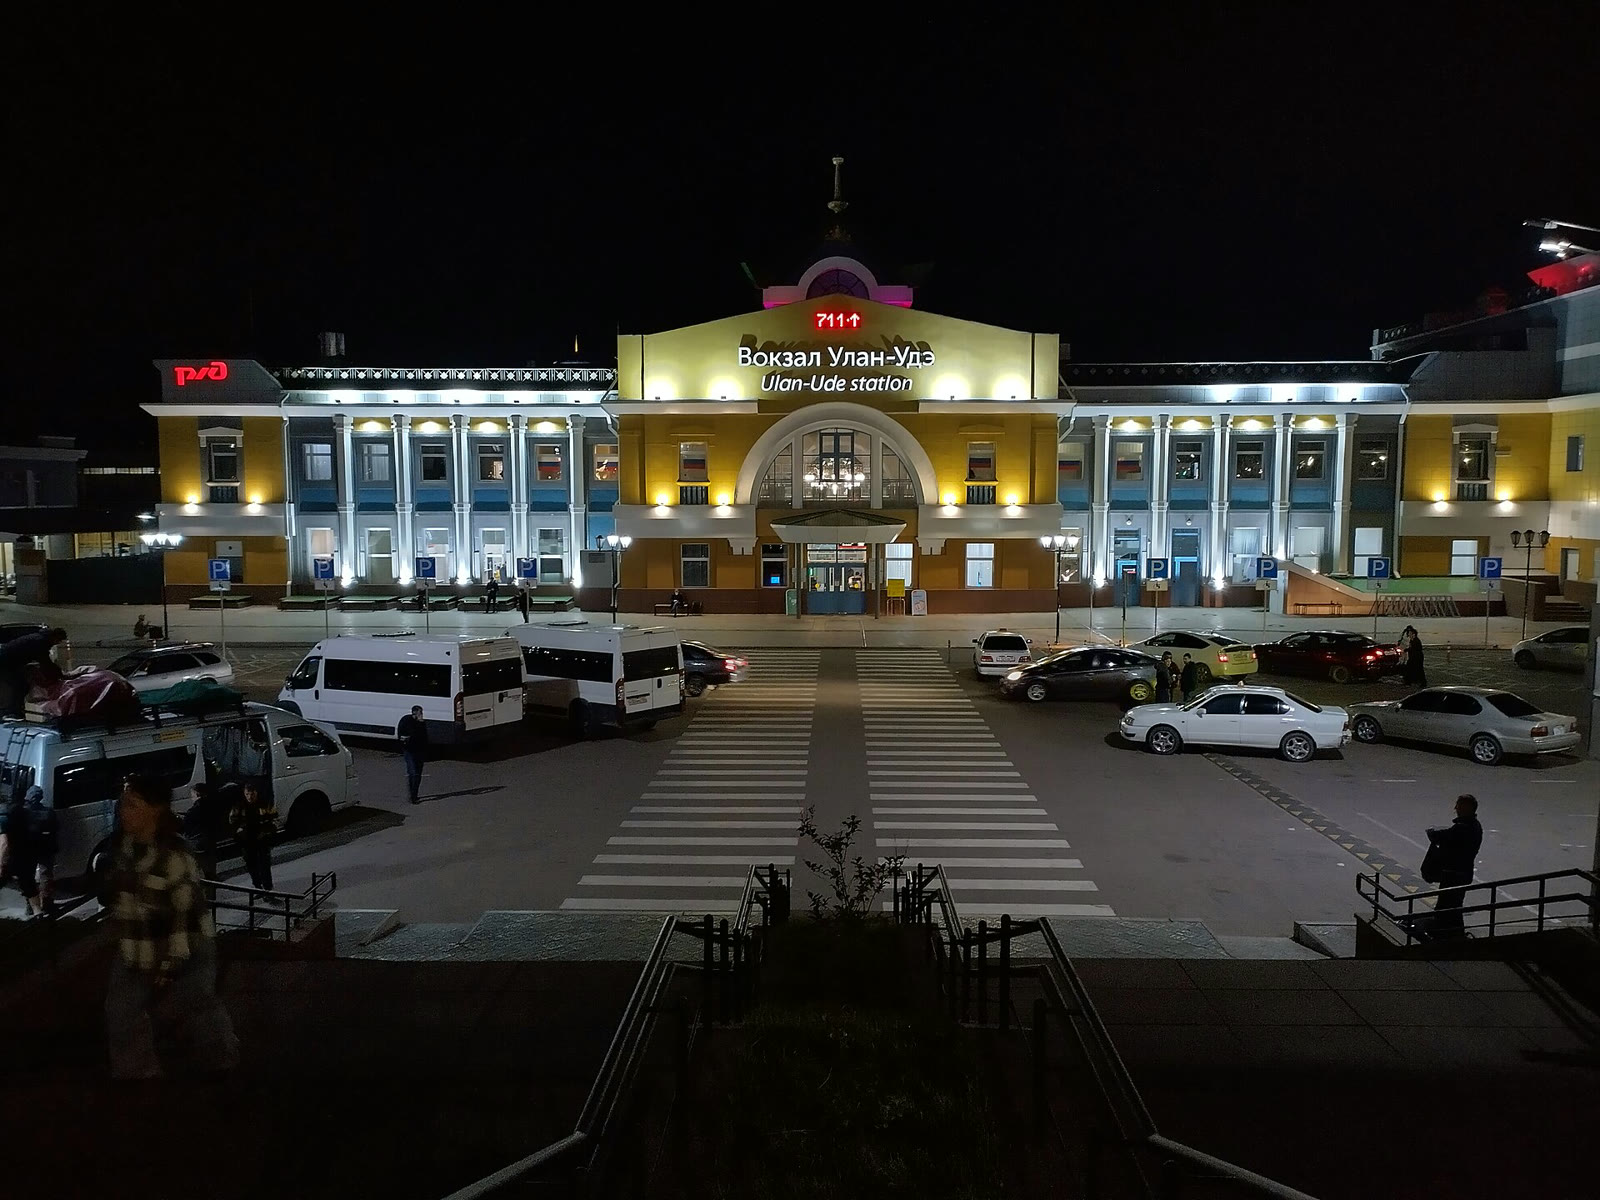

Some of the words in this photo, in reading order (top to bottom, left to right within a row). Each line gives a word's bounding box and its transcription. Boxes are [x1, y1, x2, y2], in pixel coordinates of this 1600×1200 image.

[738, 347, 821, 367] Вокзал
[827, 346, 936, 369] Улан-Удэ
[761, 374, 846, 391] Ulan-Ude
[849, 374, 913, 391] station
[213, 561, 225, 579] P
[318, 560, 330, 578] P
[420, 559, 432, 577] P
[522, 559, 533, 577] P
[1151, 559, 1164, 577] P
[1261, 559, 1274, 577] P
[1373, 560, 1385, 576] P
[1484, 559, 1498, 577] P
